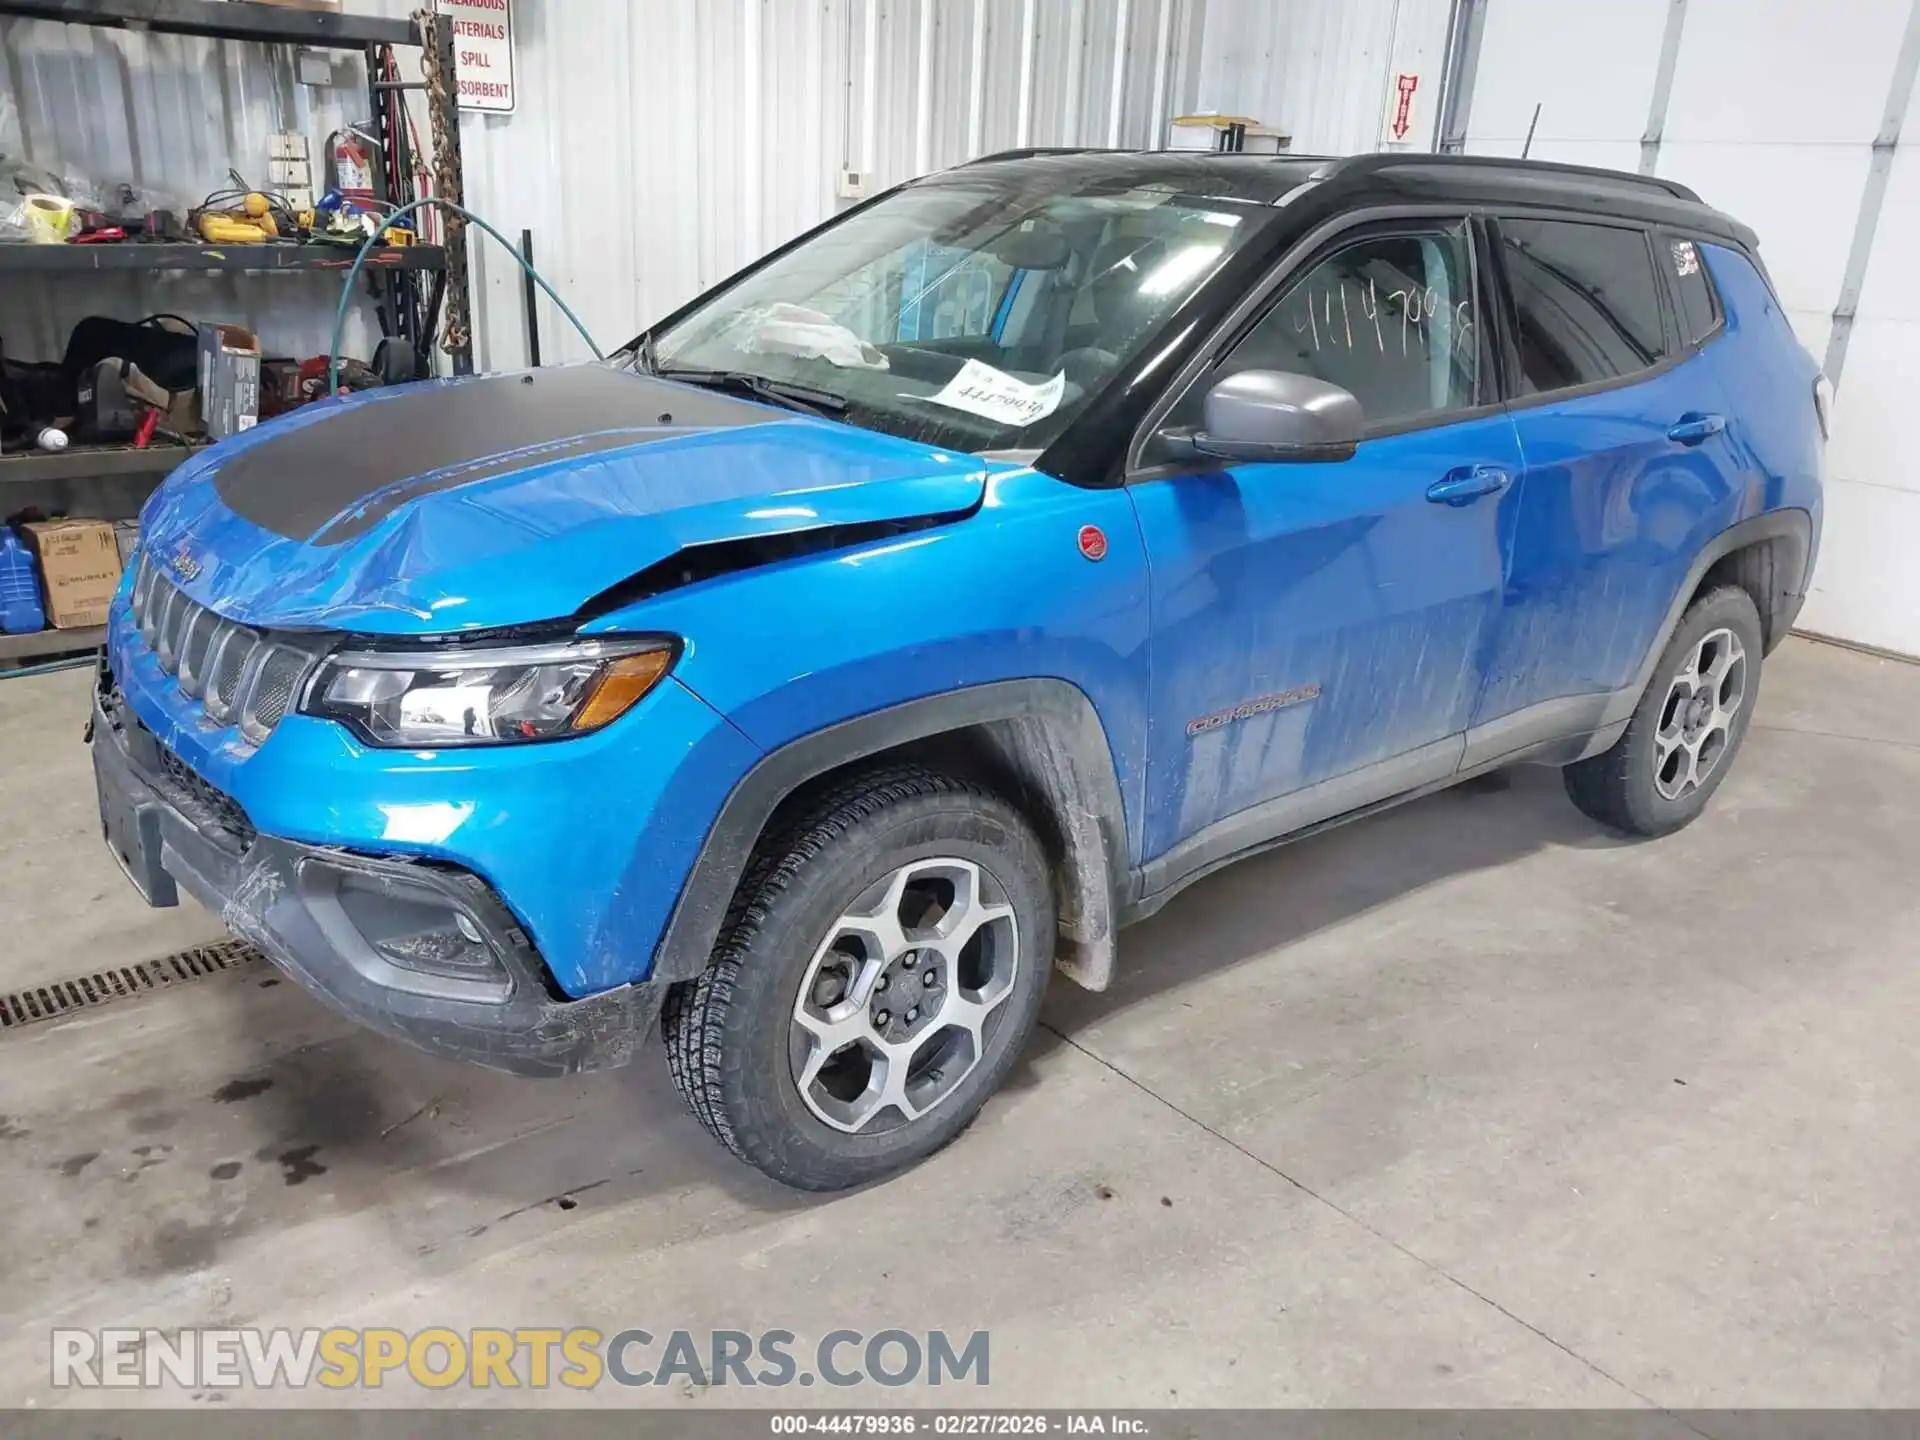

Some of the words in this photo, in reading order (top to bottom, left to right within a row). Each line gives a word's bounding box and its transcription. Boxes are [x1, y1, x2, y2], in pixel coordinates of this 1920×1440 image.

[452, 21, 505, 40] ATERIALS
[460, 51, 491, 68] SPILL
[456, 80, 509, 98] SORBENT
